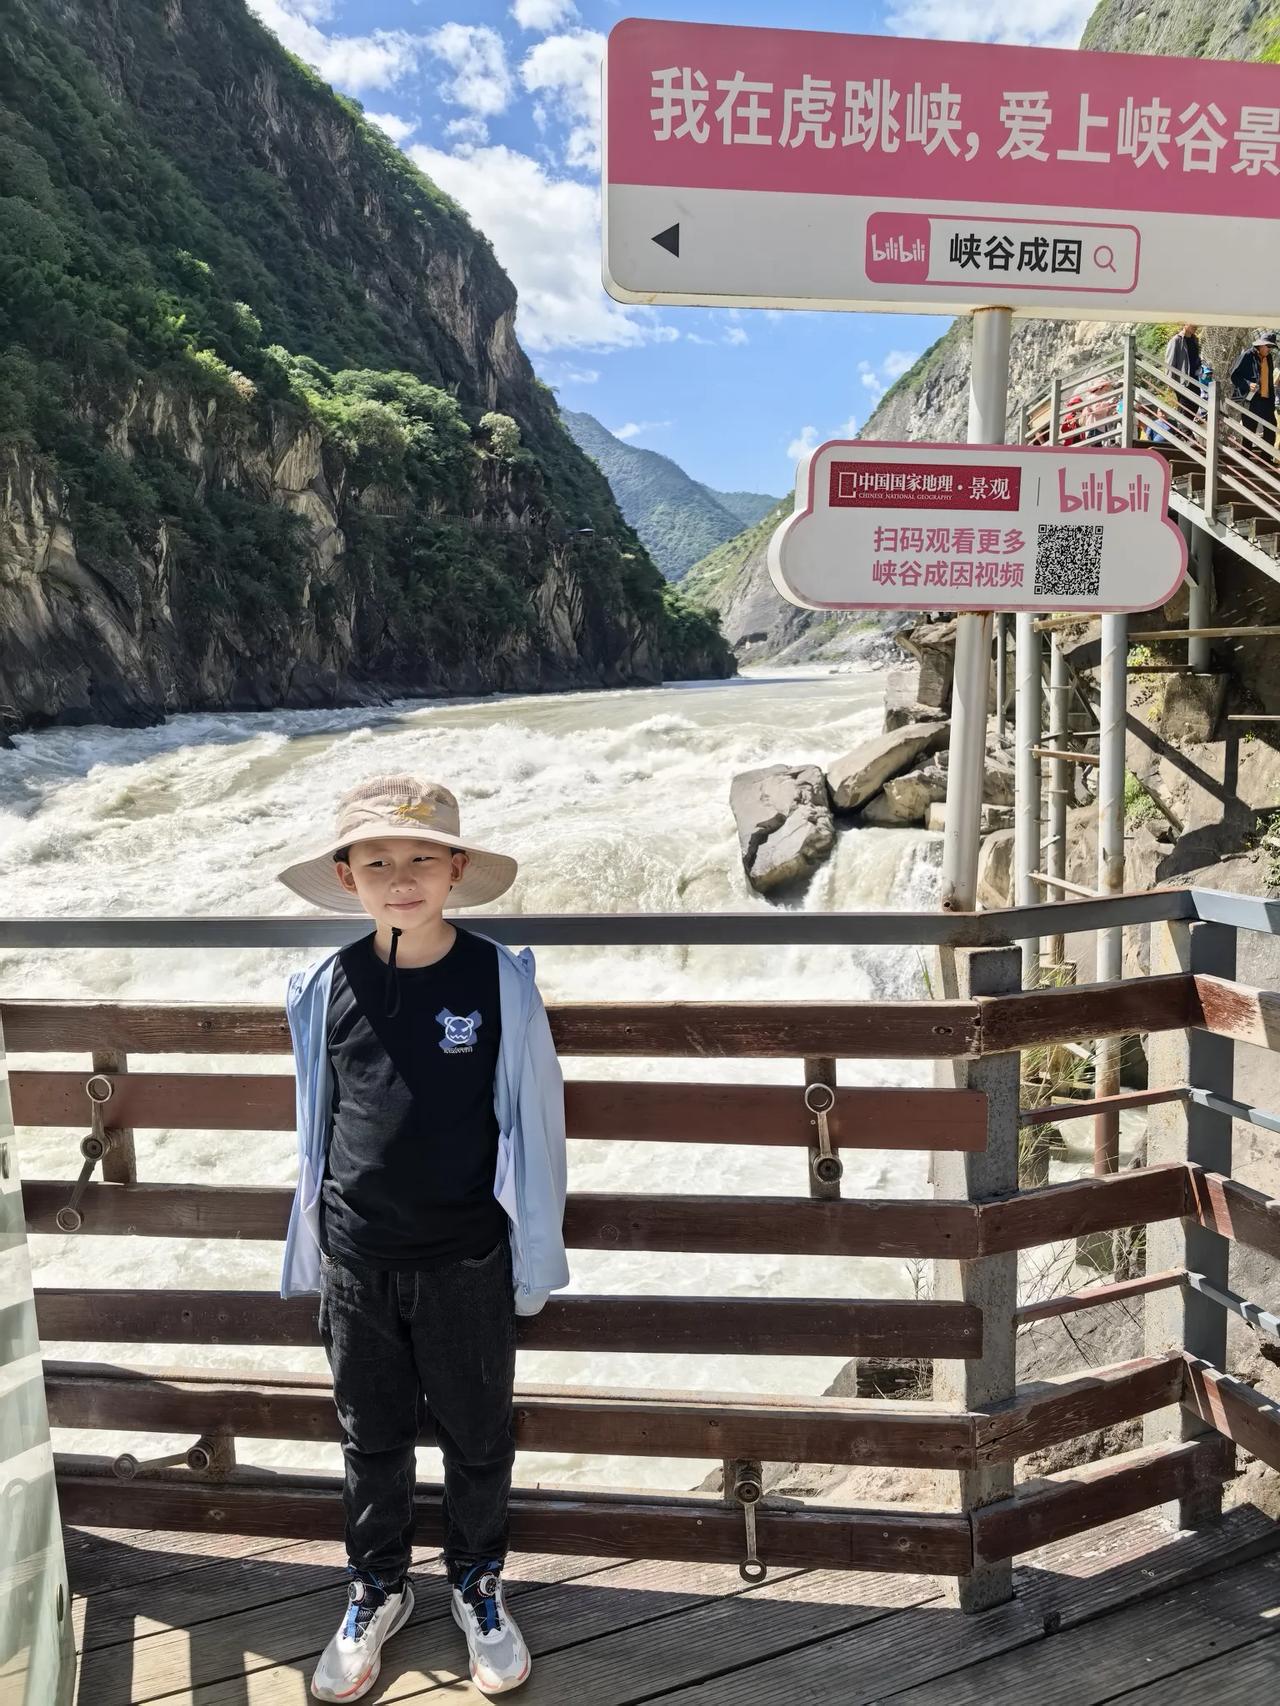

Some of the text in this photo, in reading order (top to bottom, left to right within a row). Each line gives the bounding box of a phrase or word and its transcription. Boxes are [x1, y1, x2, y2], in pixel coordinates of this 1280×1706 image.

[871, 233, 925, 263] bilibili
[949, 233, 1082, 274] 峡谷成因
[1058, 467, 1150, 514] bilibili
[873, 526, 1026, 555] 扫码观看更多
[872, 560, 1025, 588] 峡谷成因视频
